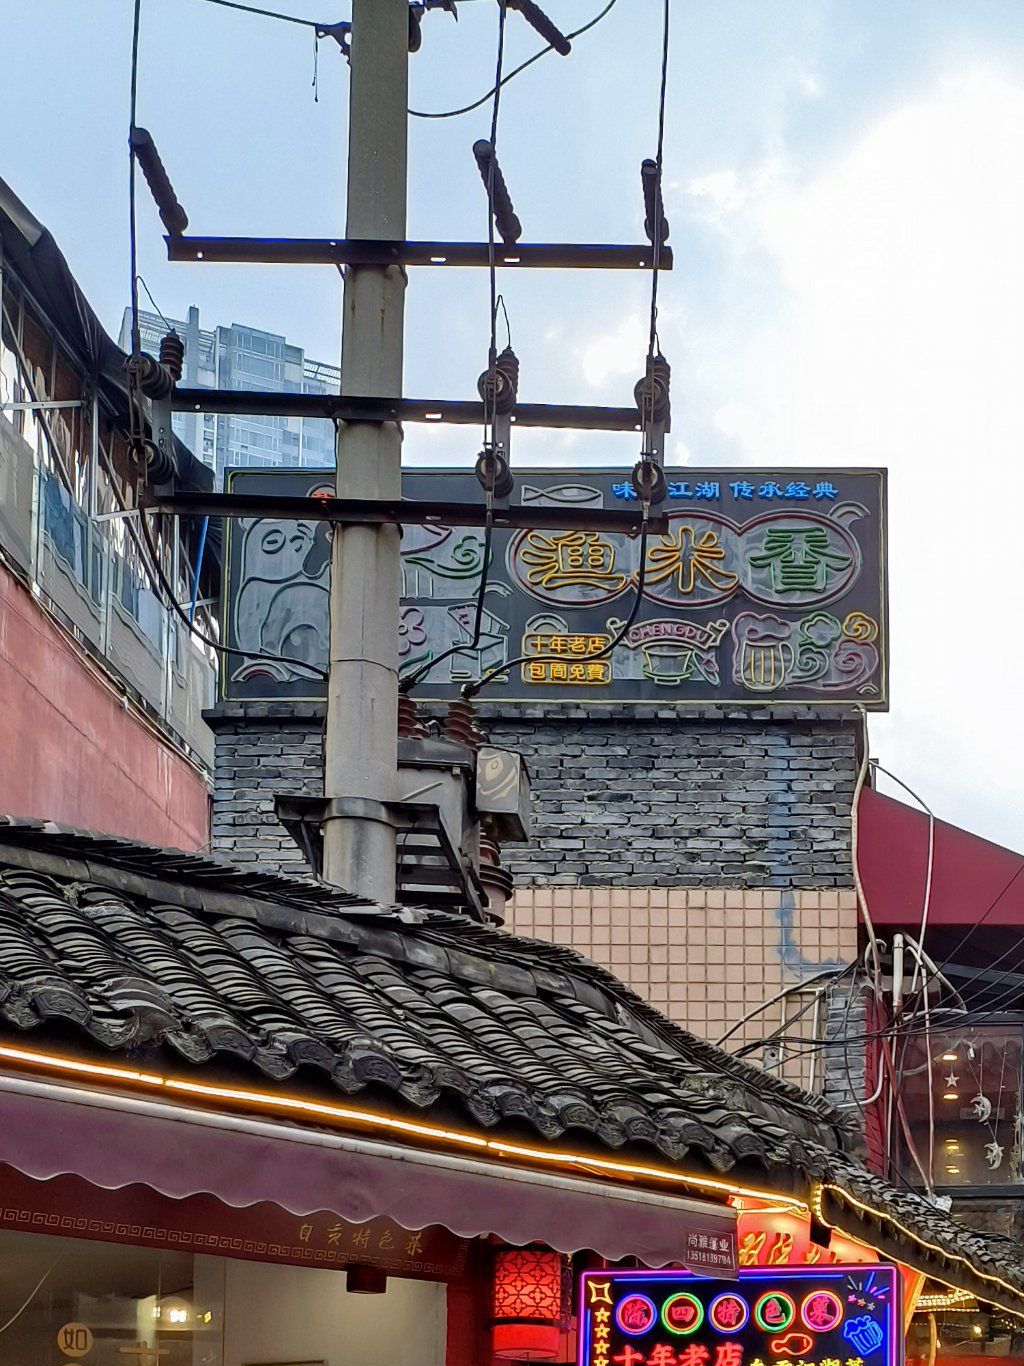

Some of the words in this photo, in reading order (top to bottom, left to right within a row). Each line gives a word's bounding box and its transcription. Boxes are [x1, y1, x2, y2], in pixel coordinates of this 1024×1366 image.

[611, 480, 720, 499] 味江湖
[730, 480, 839, 499] 传承经典
[629, 623, 708, 643] CHENGDU
[529, 636, 606, 653] 十年老店
[529, 661, 606, 680] 包間免費
[299, 1222, 423, 1257] 自贡特色菜
